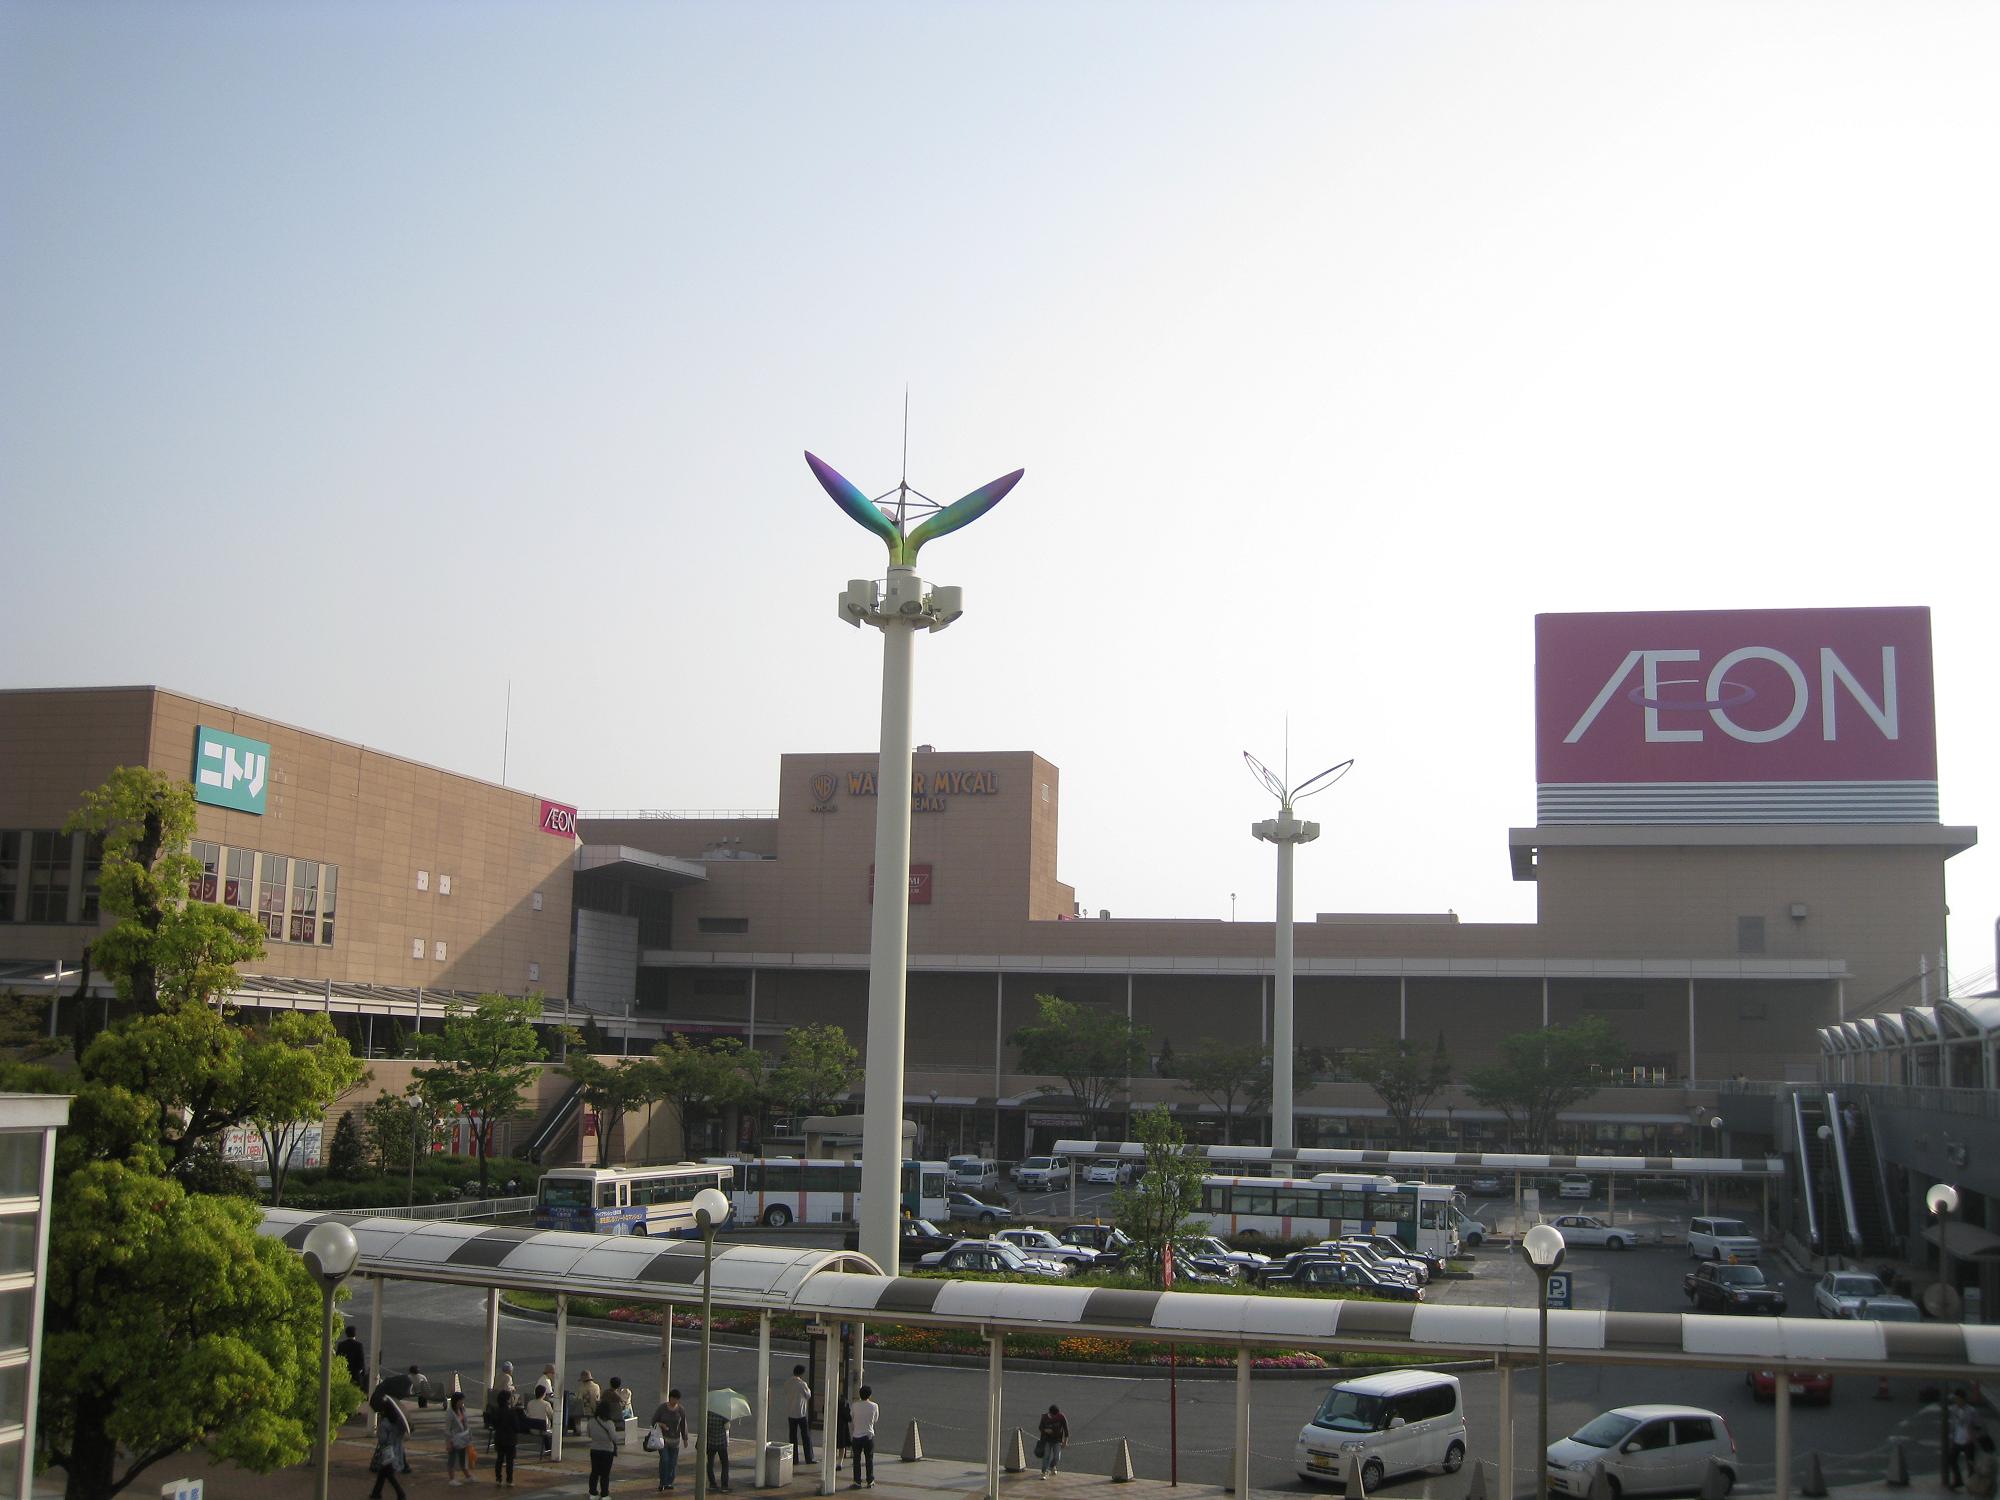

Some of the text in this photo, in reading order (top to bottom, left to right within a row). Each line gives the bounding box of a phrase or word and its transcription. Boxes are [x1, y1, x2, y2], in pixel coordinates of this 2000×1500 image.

[200, 741, 266, 798] ニトリ
[935, 771, 996, 795] MYCAL
[1550, 1279, 1562, 1295] P
